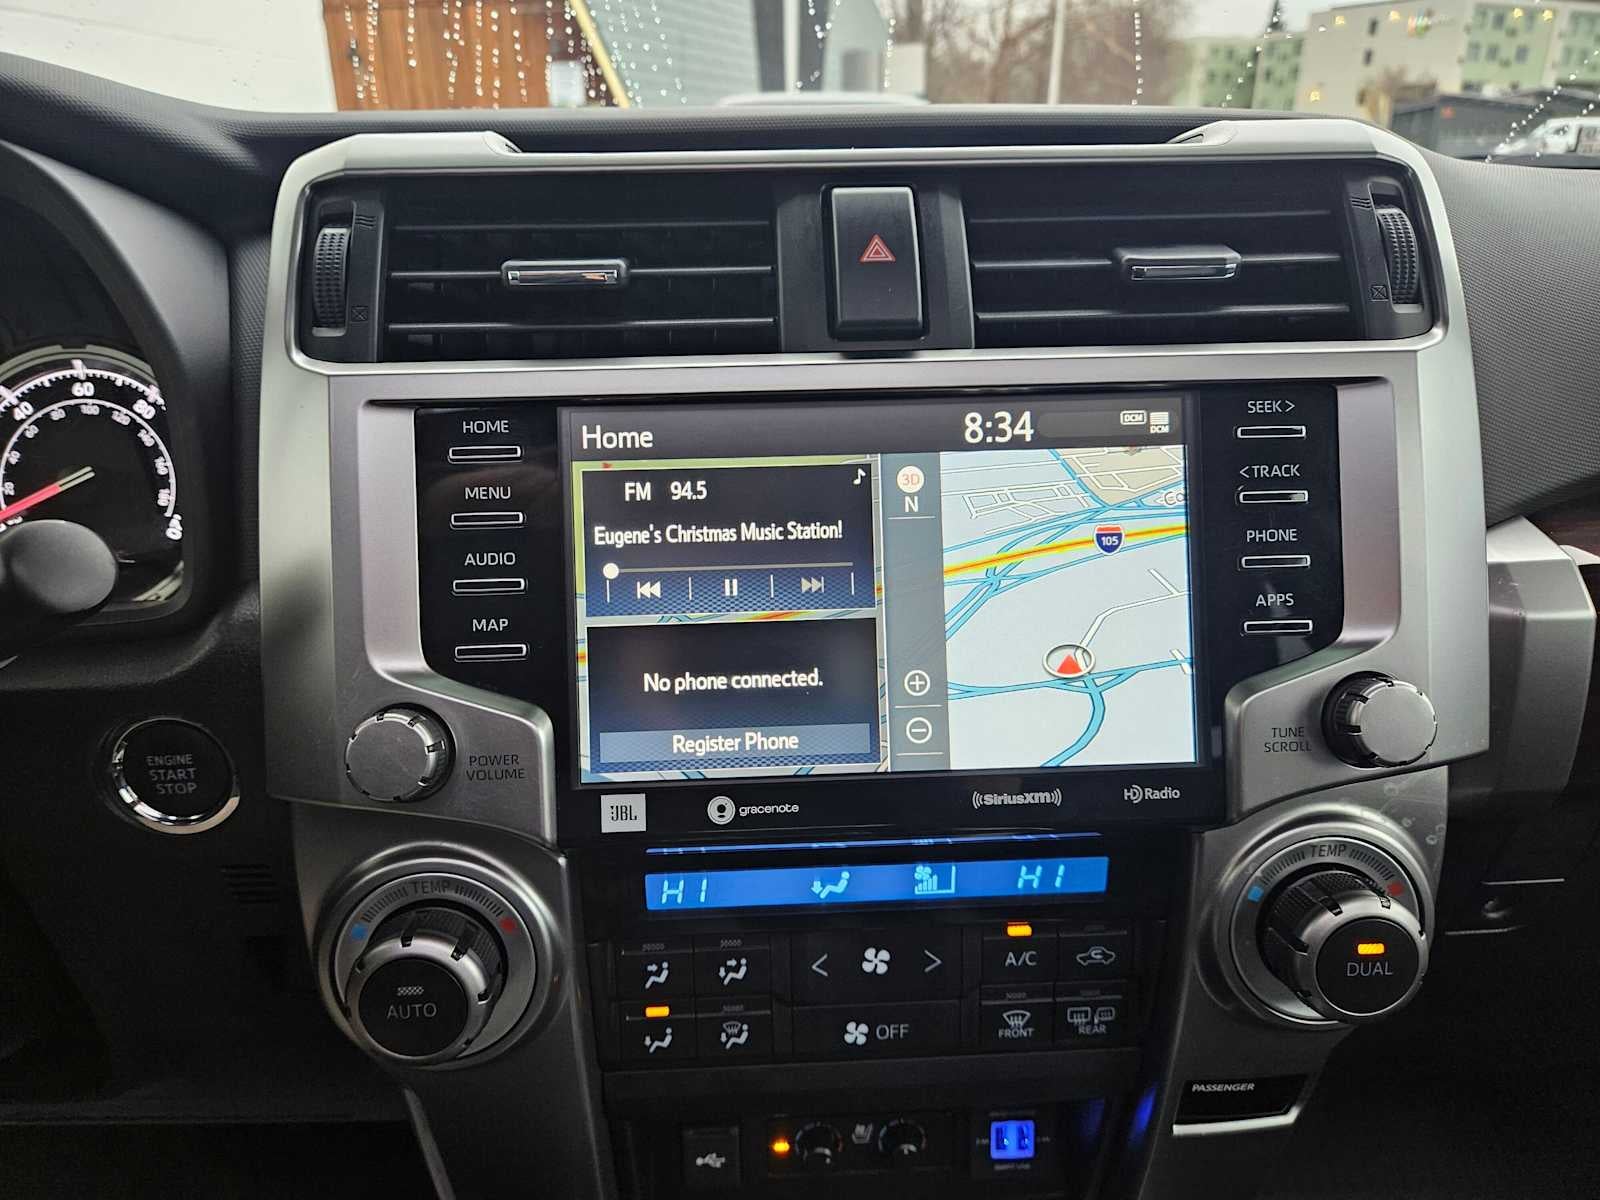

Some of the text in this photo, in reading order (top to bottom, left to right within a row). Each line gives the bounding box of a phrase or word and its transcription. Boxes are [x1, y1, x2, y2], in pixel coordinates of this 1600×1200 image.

[71, 381, 95, 397] 60
[13, 401, 34, 421] 40
[132, 398, 156, 420] 80
[462, 420, 510, 433] HOME
[963, 410, 1034, 444] 8:34
[581, 425, 654, 450] Home
[901, 473, 920, 486] 3D
[464, 486, 512, 500] MENU
[624, 480, 708, 501] FM 94.5
[904, 496, 919, 513] N
[594, 519, 843, 548] Eugene's Christmas Music Station!
[1100, 536, 1118, 546] 105
[1246, 528, 1298, 543] PHONE
[464, 552, 516, 566] AUDIO
[1255, 592, 1295, 607] APPS
[472, 618, 509, 632] MAP
[643, 667, 824, 695] No phone connected.
[1271, 727, 1305, 739] TUNE
[672, 731, 799, 757] Register Phone
[1263, 740, 1312, 754] SCROLL
[146, 753, 193, 766] ENGINE
[468, 754, 520, 767] POWER
[149, 768, 197, 780] START
[465, 768, 526, 782] VOLUME
[155, 782, 198, 795] STOP
[1144, 787, 1181, 801] Radio
[610, 805, 638, 823] JBL
[738, 802, 800, 818] gracenote
[1310, 844, 1348, 860] TEMP
[412, 880, 452, 896] TEMP
[1005, 951, 1037, 967] A/C
[1346, 962, 1393, 978] DUAL
[386, 1003, 438, 1020] AUTO
[876, 1024, 909, 1040] OFF
[998, 1028, 1034, 1039] FRONT
[1078, 1025, 1107, 1036] REAR
[1192, 1083, 1255, 1093] PASSENGER
